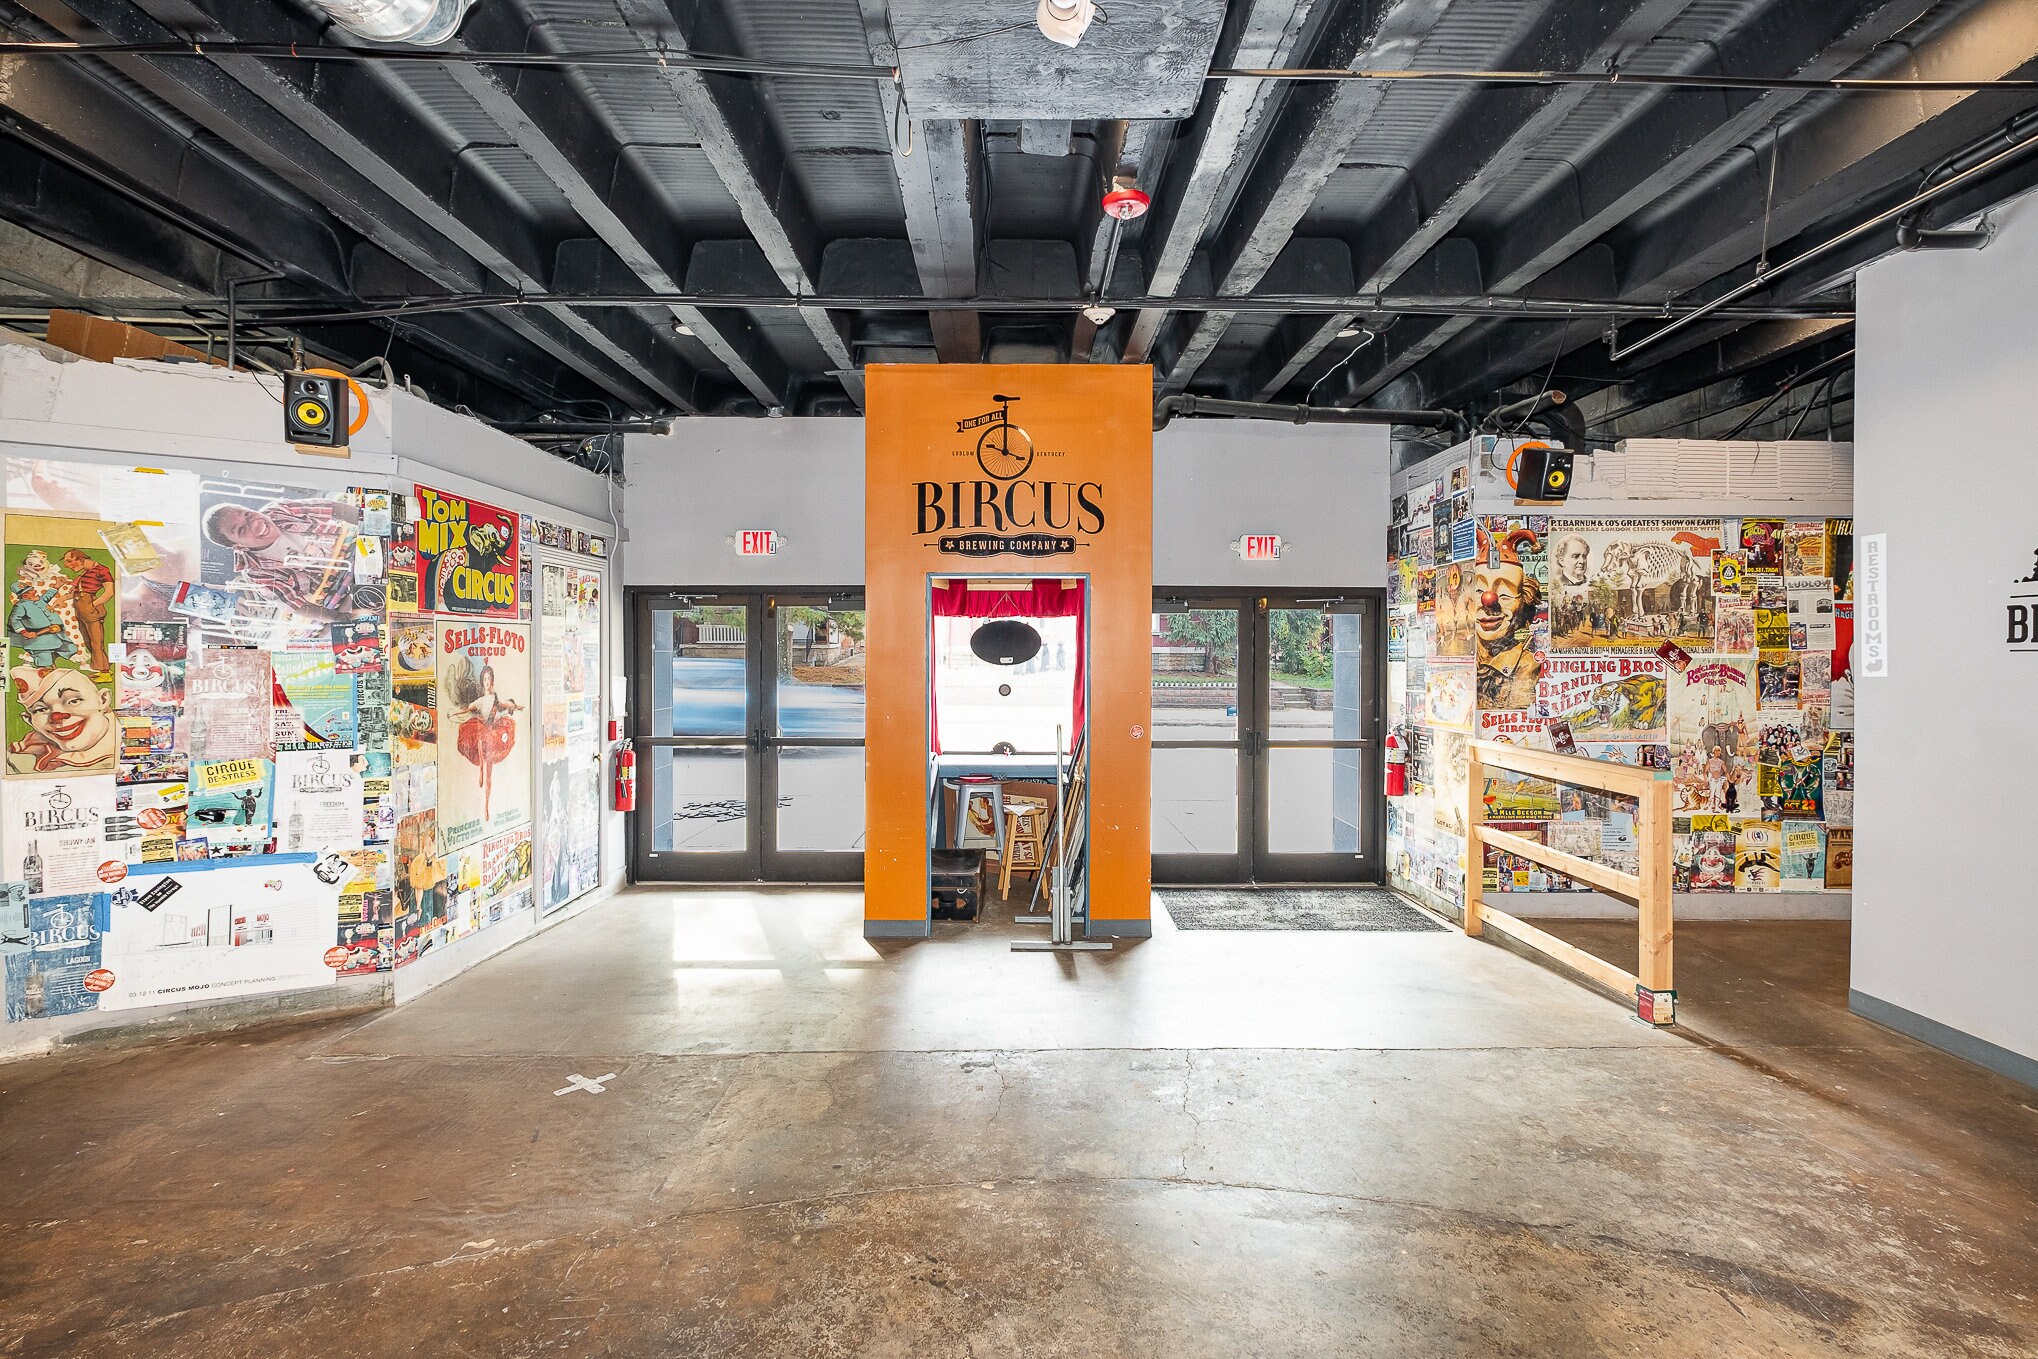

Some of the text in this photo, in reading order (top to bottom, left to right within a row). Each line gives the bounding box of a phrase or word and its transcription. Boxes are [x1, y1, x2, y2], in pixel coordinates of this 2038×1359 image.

[964, 412, 1004, 429] ONE FOR ALL
[422, 489, 466, 523] TOM
[911, 480, 1105, 536] BIRCUS
[1621, 519, 1660, 527] GREATEST
[1661, 519, 1685, 527] SHOW
[1685, 519, 1696, 527] ON
[1697, 519, 1721, 528] EARTH
[418, 519, 468, 556] MIX
[743, 532, 772, 554] EXIT
[959, 540, 1058, 551] BREWING COMPANY
[1247, 536, 1276, 559] EXIT
[453, 566, 515, 606] CIRCUS
[1865, 541, 1883, 658] RESTROOMS
[468, 646, 507, 658] CIRCUS
[1540, 658, 1664, 680] RINGLING BROS
[1538, 673, 1603, 698] BARNUM
[1482, 712, 1518, 728] SELLS
[1498, 725, 1542, 733] CIRCUS
[206, 760, 255, 776] CIRQUE
[207, 769, 257, 784] DE-STRESS
[1801, 799, 1816, 811] 23
[25, 807, 99, 828] BIRCUS
[1788, 833, 1816, 842] CIRQUE
[157, 987, 186, 995] CIRCUS
[188, 983, 210, 992] MOJO
